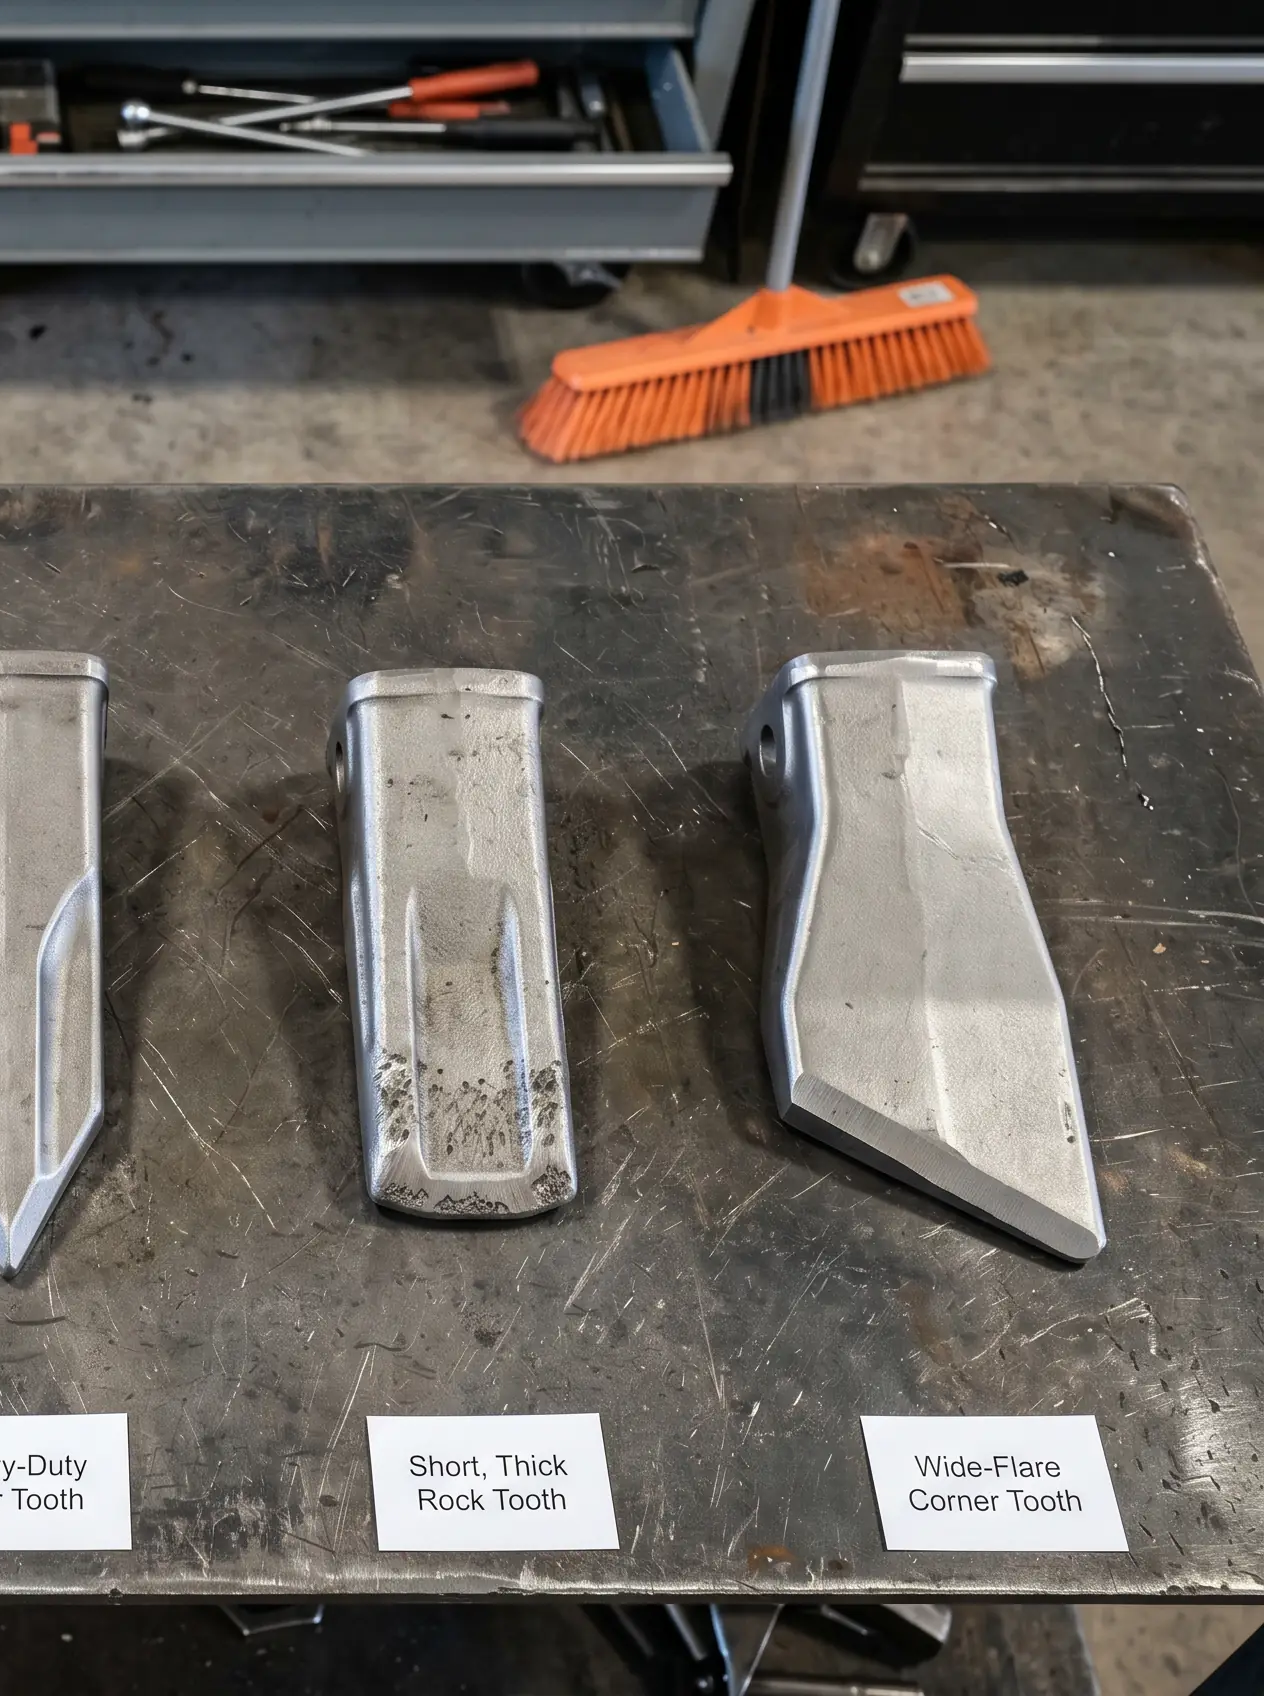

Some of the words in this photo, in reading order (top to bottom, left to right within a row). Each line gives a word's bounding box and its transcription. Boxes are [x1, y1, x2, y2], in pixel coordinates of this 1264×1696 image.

[409, 1454, 487, 1481] Short,
[495, 1454, 569, 1477] Thick
[914, 1455, 1061, 1478] Wide-Flare
[10, 1487, 84, 1511] Tooth
[418, 1488, 486, 1511] Rock
[492, 1487, 567, 1511] Tooth
[908, 1488, 999, 1512] Corner
[1005, 1489, 1083, 1512] Tooth
